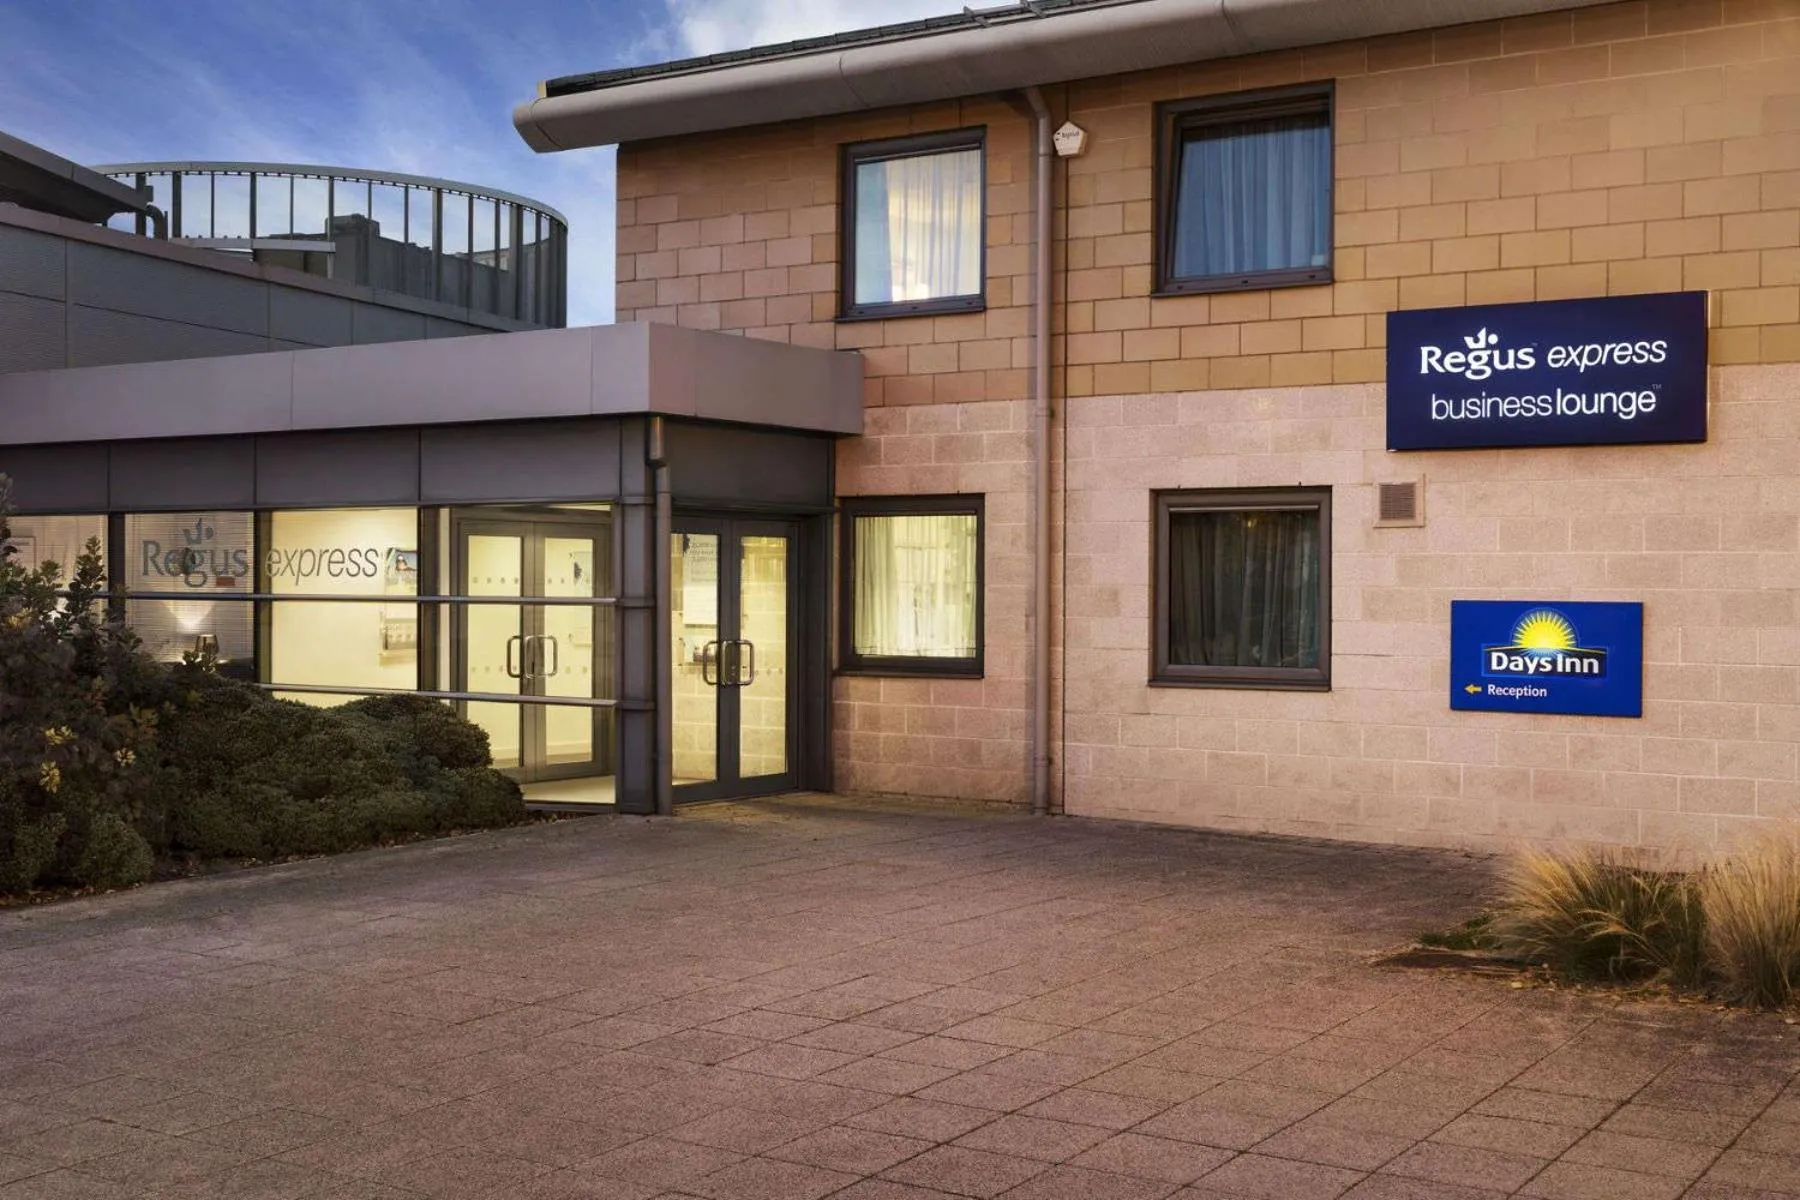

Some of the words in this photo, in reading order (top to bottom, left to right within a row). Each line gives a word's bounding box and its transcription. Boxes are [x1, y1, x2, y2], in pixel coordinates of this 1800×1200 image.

[1420, 345, 1536, 381] Regus
[1547, 340, 1668, 373] express
[142, 540, 250, 588] Regus
[265, 547, 378, 586] express
[1491, 652, 1553, 675] Days
[1556, 653, 1599, 674] Inn
[1487, 683, 1548, 700] Reception
